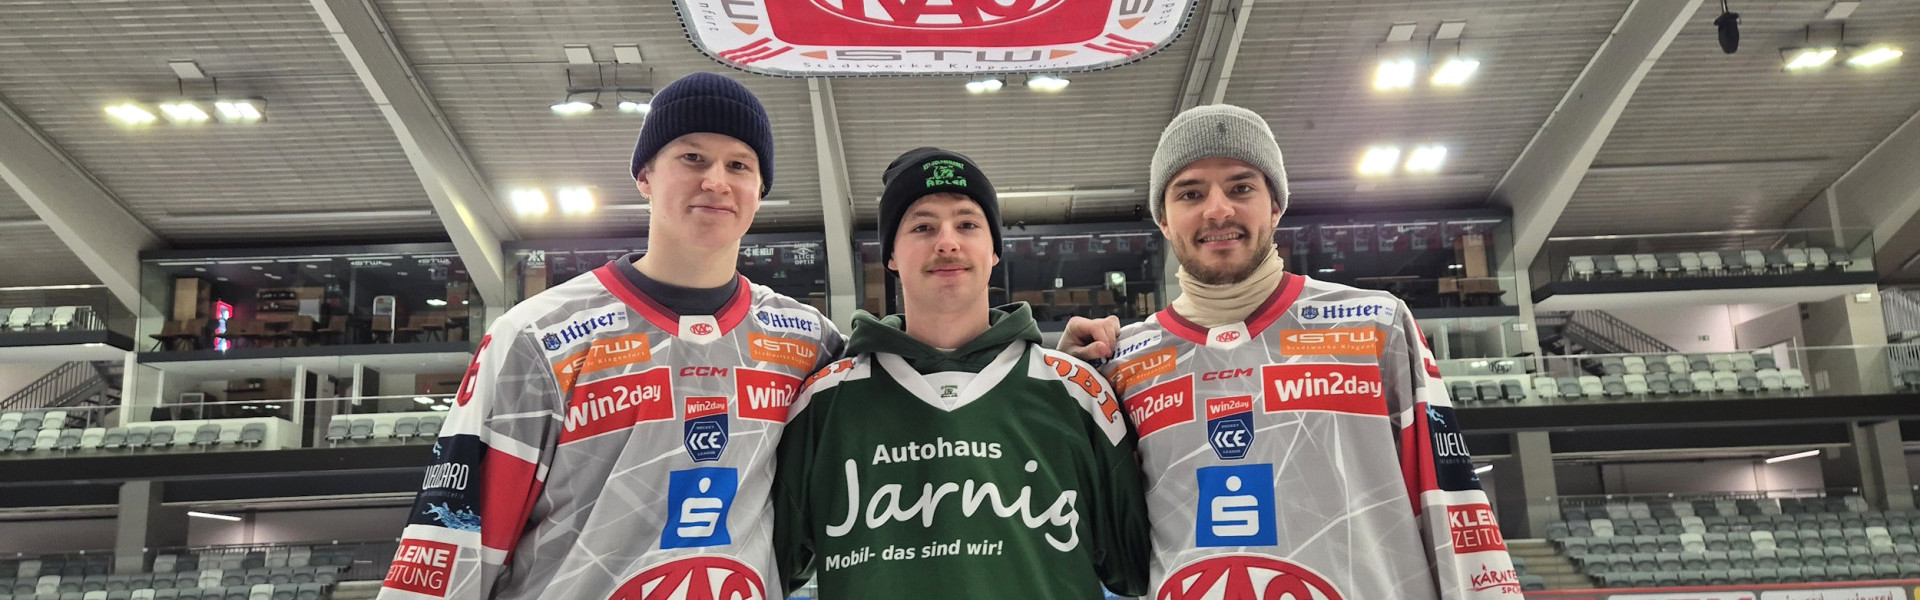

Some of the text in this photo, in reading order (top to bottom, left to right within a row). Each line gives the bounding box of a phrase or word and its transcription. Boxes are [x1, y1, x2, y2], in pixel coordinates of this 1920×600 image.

[836, 50, 1042, 62] STW
[1323, 304, 1383, 319] Hirter
[560, 312, 616, 344] Hirter
[770, 312, 813, 332] Hirter
[1300, 331, 1375, 344] STW
[763, 339, 809, 358] STW
[679, 366, 729, 377] CCM
[1202, 368, 1253, 381] CCM
[1274, 372, 1382, 402] win2day
[564, 384, 661, 433] win2day
[688, 401, 725, 414] win2day
[1210, 400, 1249, 414] win2day
[872, 437, 1003, 466] Autohaus
[1434, 432, 1471, 457] WELL
[826, 458, 1080, 553] Jarnig
[825, 539, 1004, 572] Mobil- das sind wir!
[384, 565, 444, 590] EITUNG
